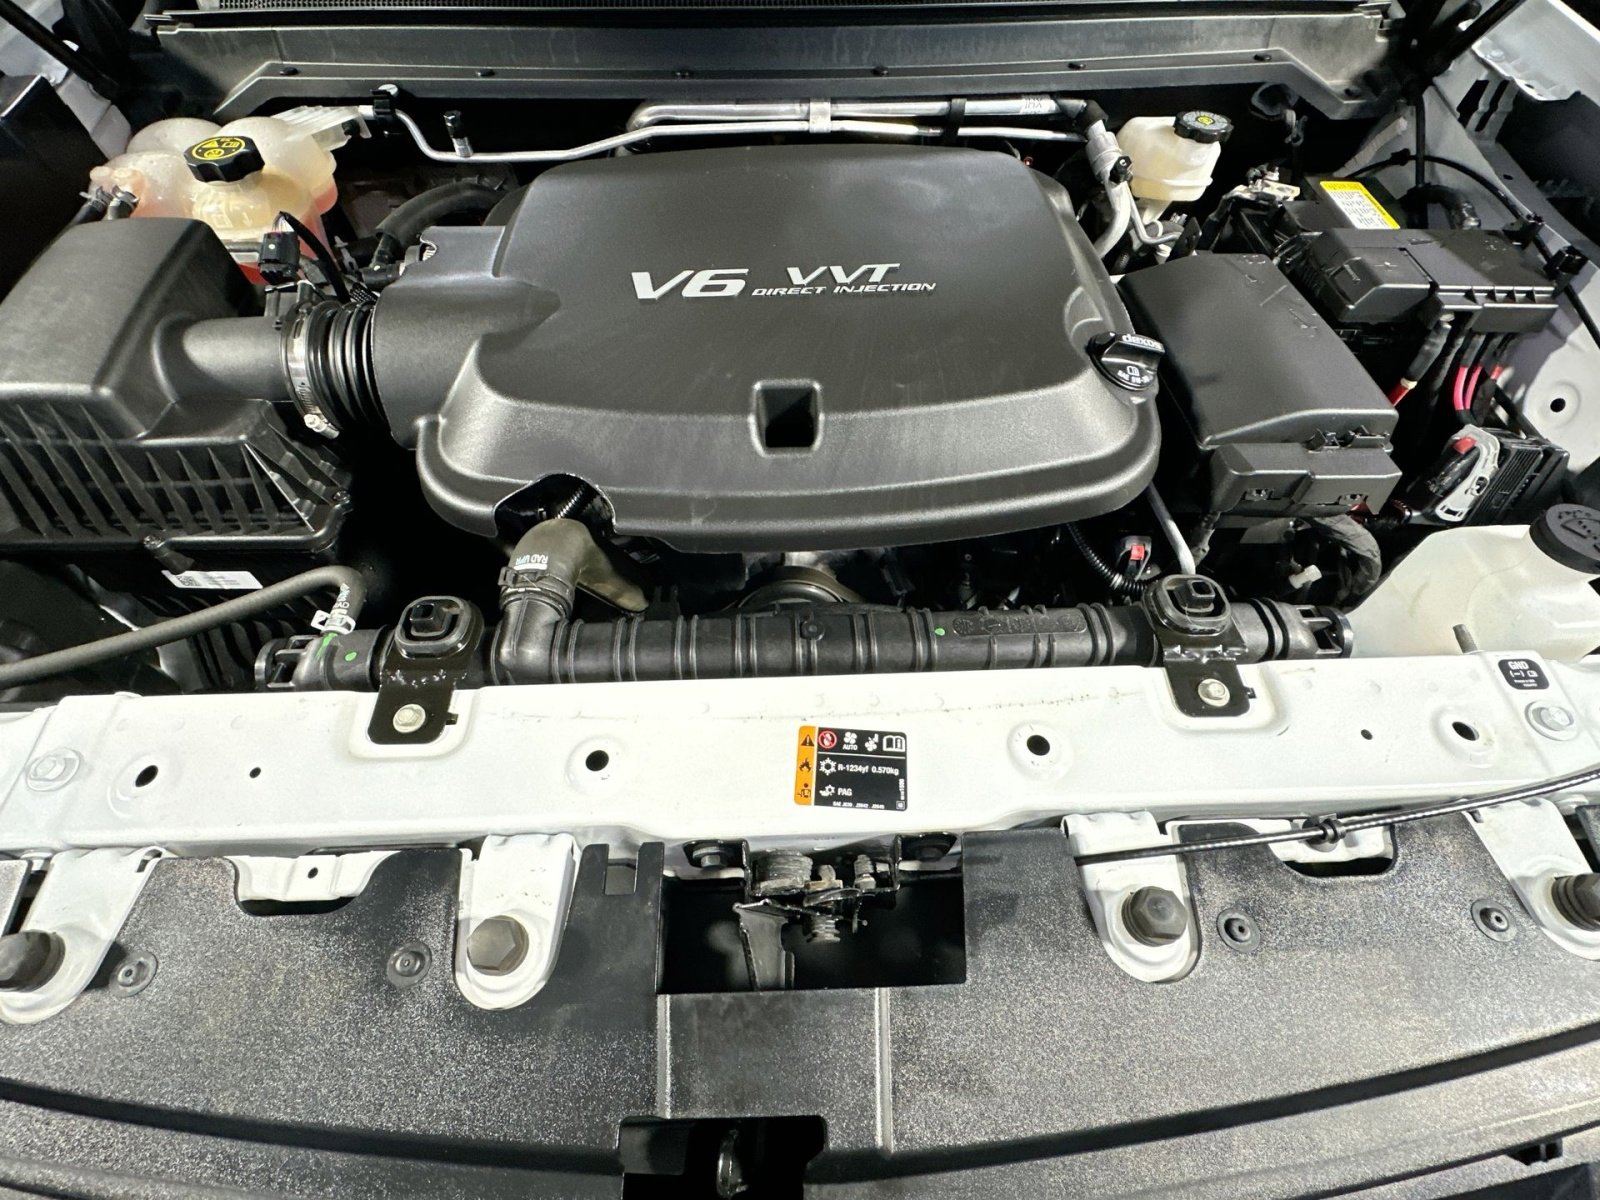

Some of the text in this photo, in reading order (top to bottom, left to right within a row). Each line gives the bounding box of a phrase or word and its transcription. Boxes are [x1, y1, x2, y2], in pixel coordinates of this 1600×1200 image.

[786, 262, 901, 286] VVT
[631, 268, 749, 300] V6
[751, 282, 937, 297] DIRECT INJECTION
[1122, 334, 1162, 349] dexos
[531, 554, 548, 564] RAD
[1508, 661, 1529, 670] GND
[842, 743, 858, 751] AUTO
[837, 763, 899, 776] R-1234yf 0.570kg
[837, 787, 853, 797] PAG
